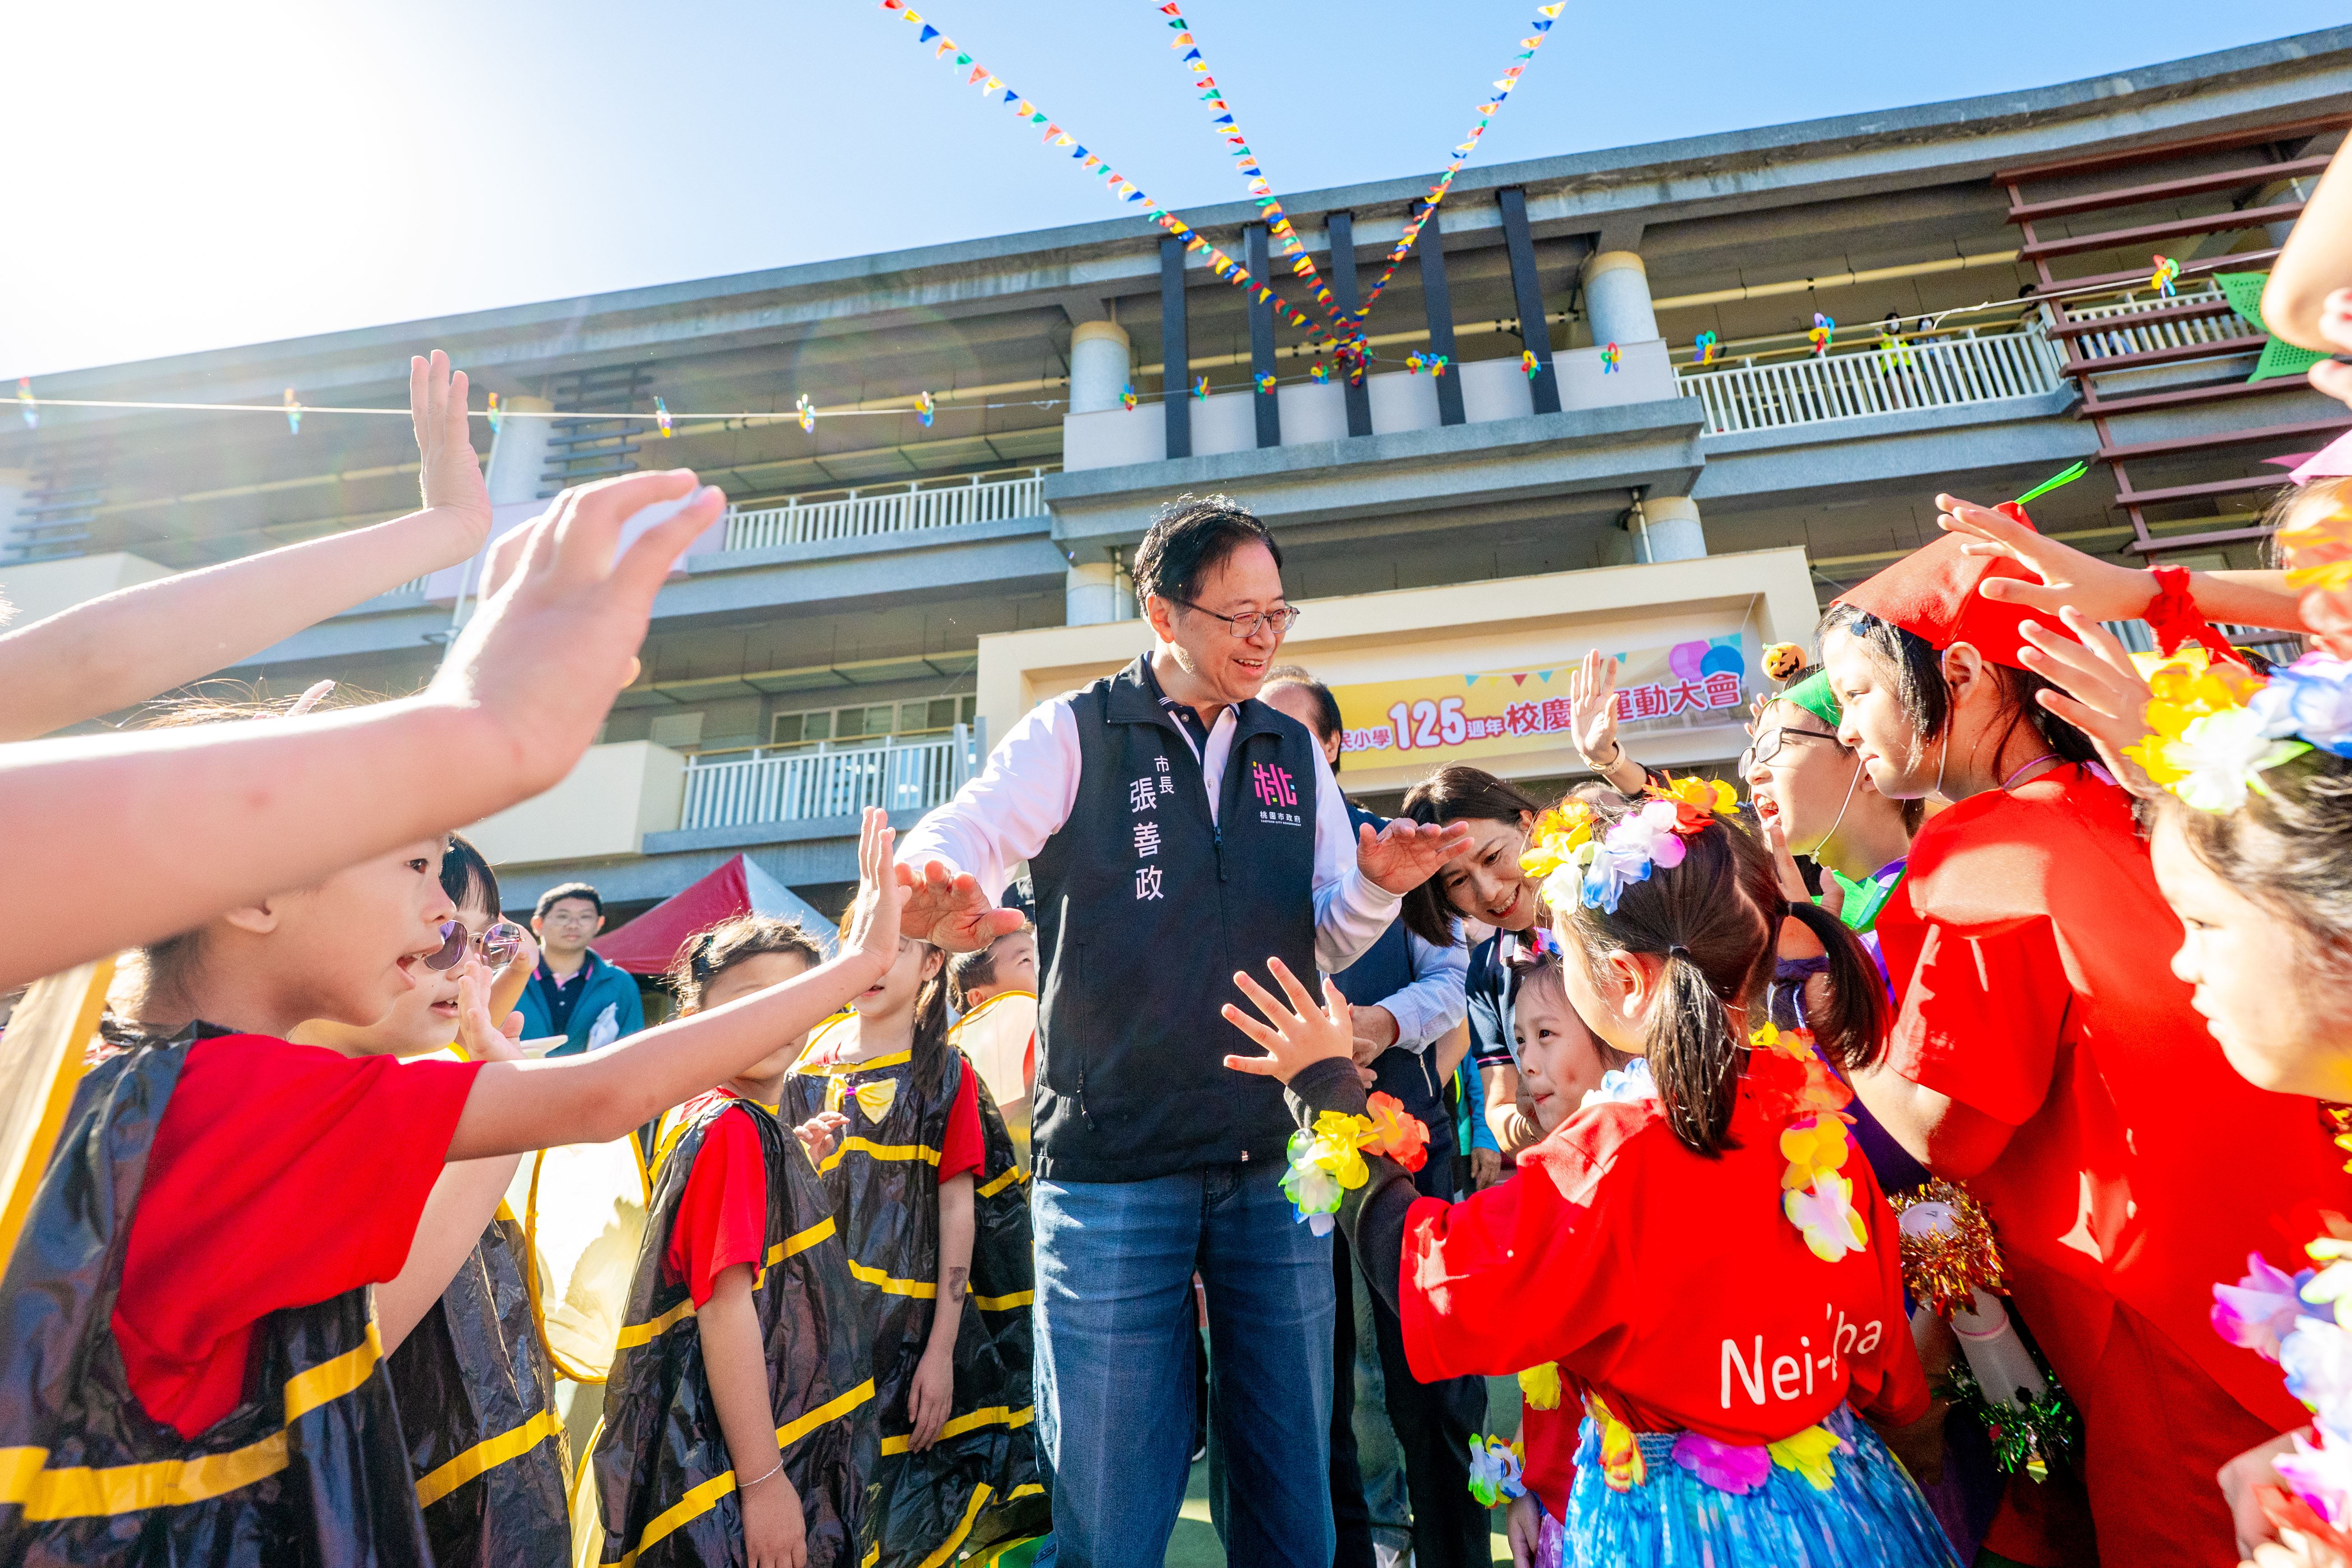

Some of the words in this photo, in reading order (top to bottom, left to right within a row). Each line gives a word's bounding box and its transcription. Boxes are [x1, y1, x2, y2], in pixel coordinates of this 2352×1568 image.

[1154, 755, 1174, 794] 市長
[1260, 811, 1300, 823] 桃園市政府
[1130, 777, 1164, 901] 張善政
